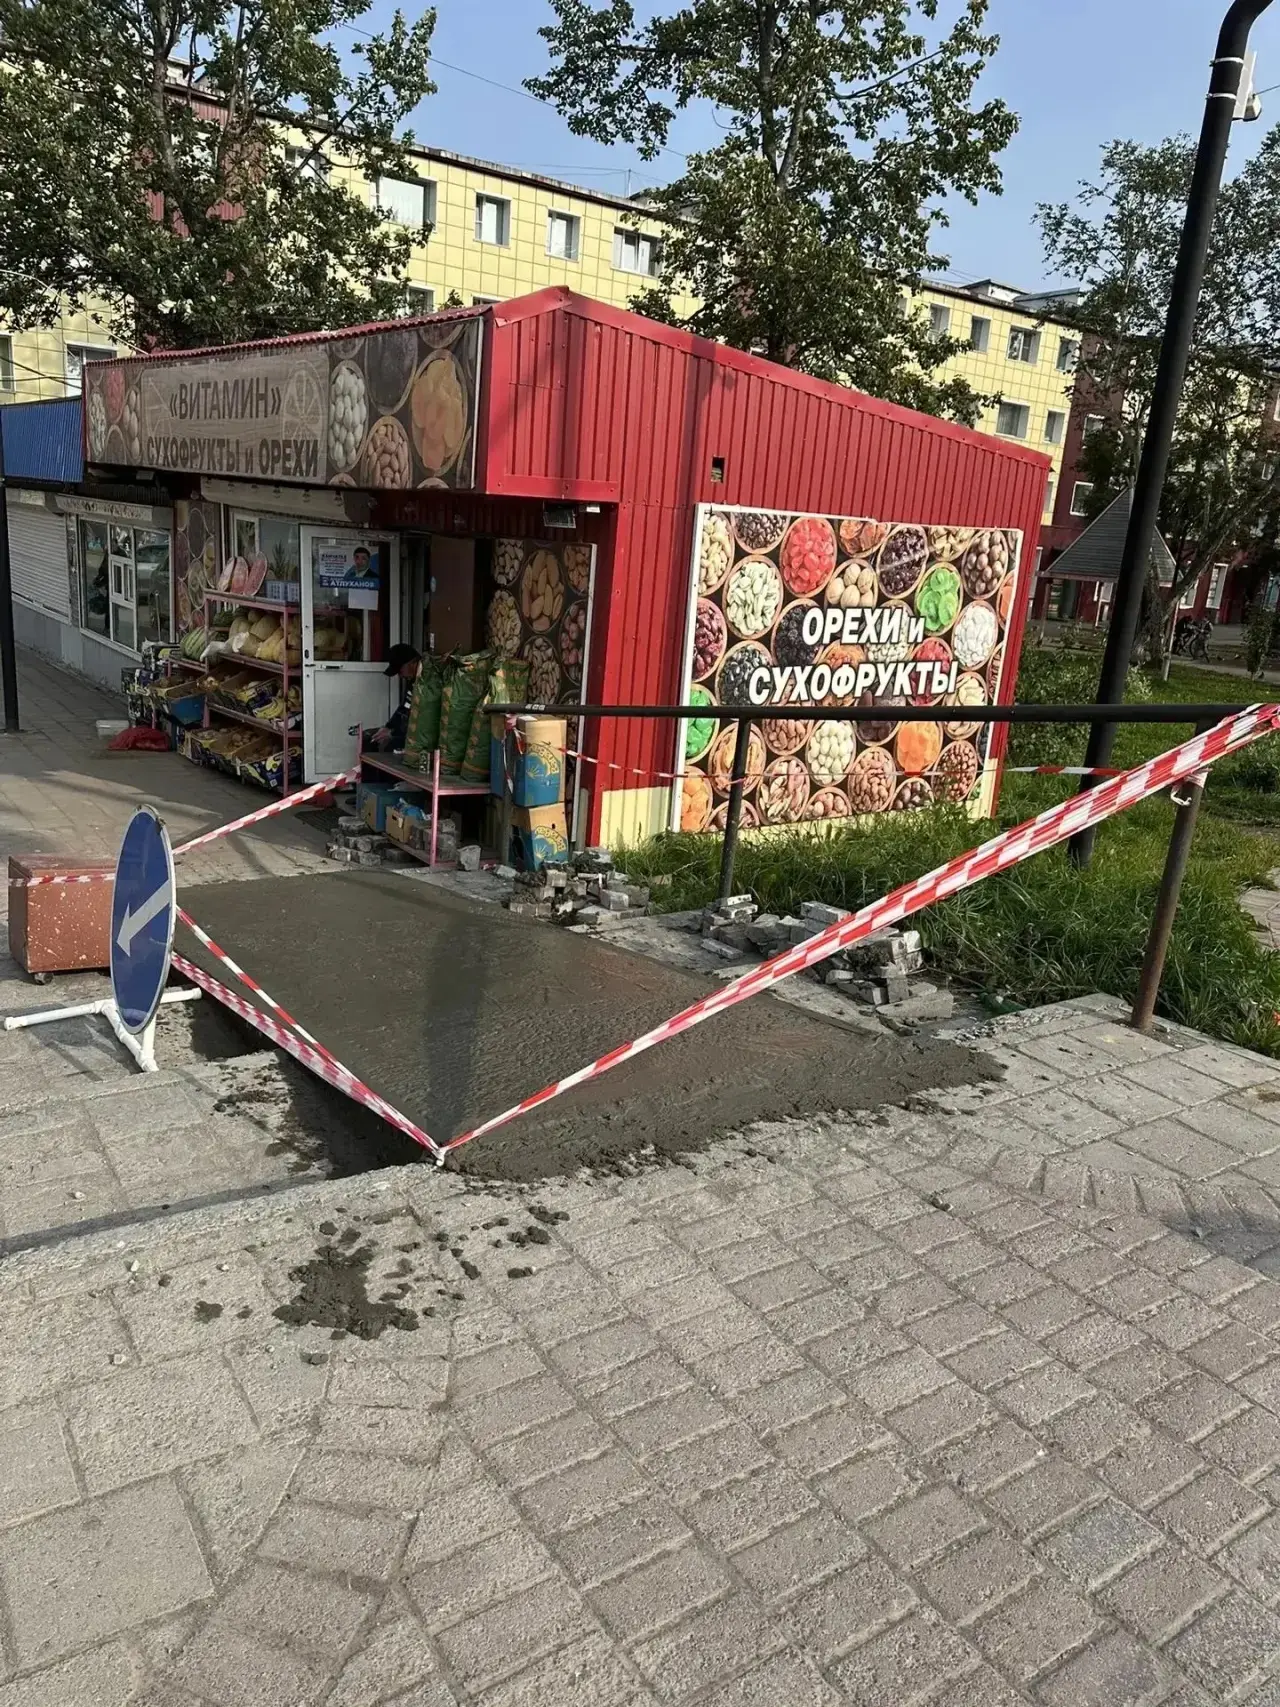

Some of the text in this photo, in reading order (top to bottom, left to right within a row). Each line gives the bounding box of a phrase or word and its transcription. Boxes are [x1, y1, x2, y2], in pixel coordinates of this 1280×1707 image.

[170, 376, 281, 420] «ВИТАМИН»
[146, 436, 319, 477] СУХОФРУКТЫ и ОРЕХИ
[802, 606, 926, 646] ОРЕХИ и
[748, 661, 957, 704] СУХОФРУКТЫ
